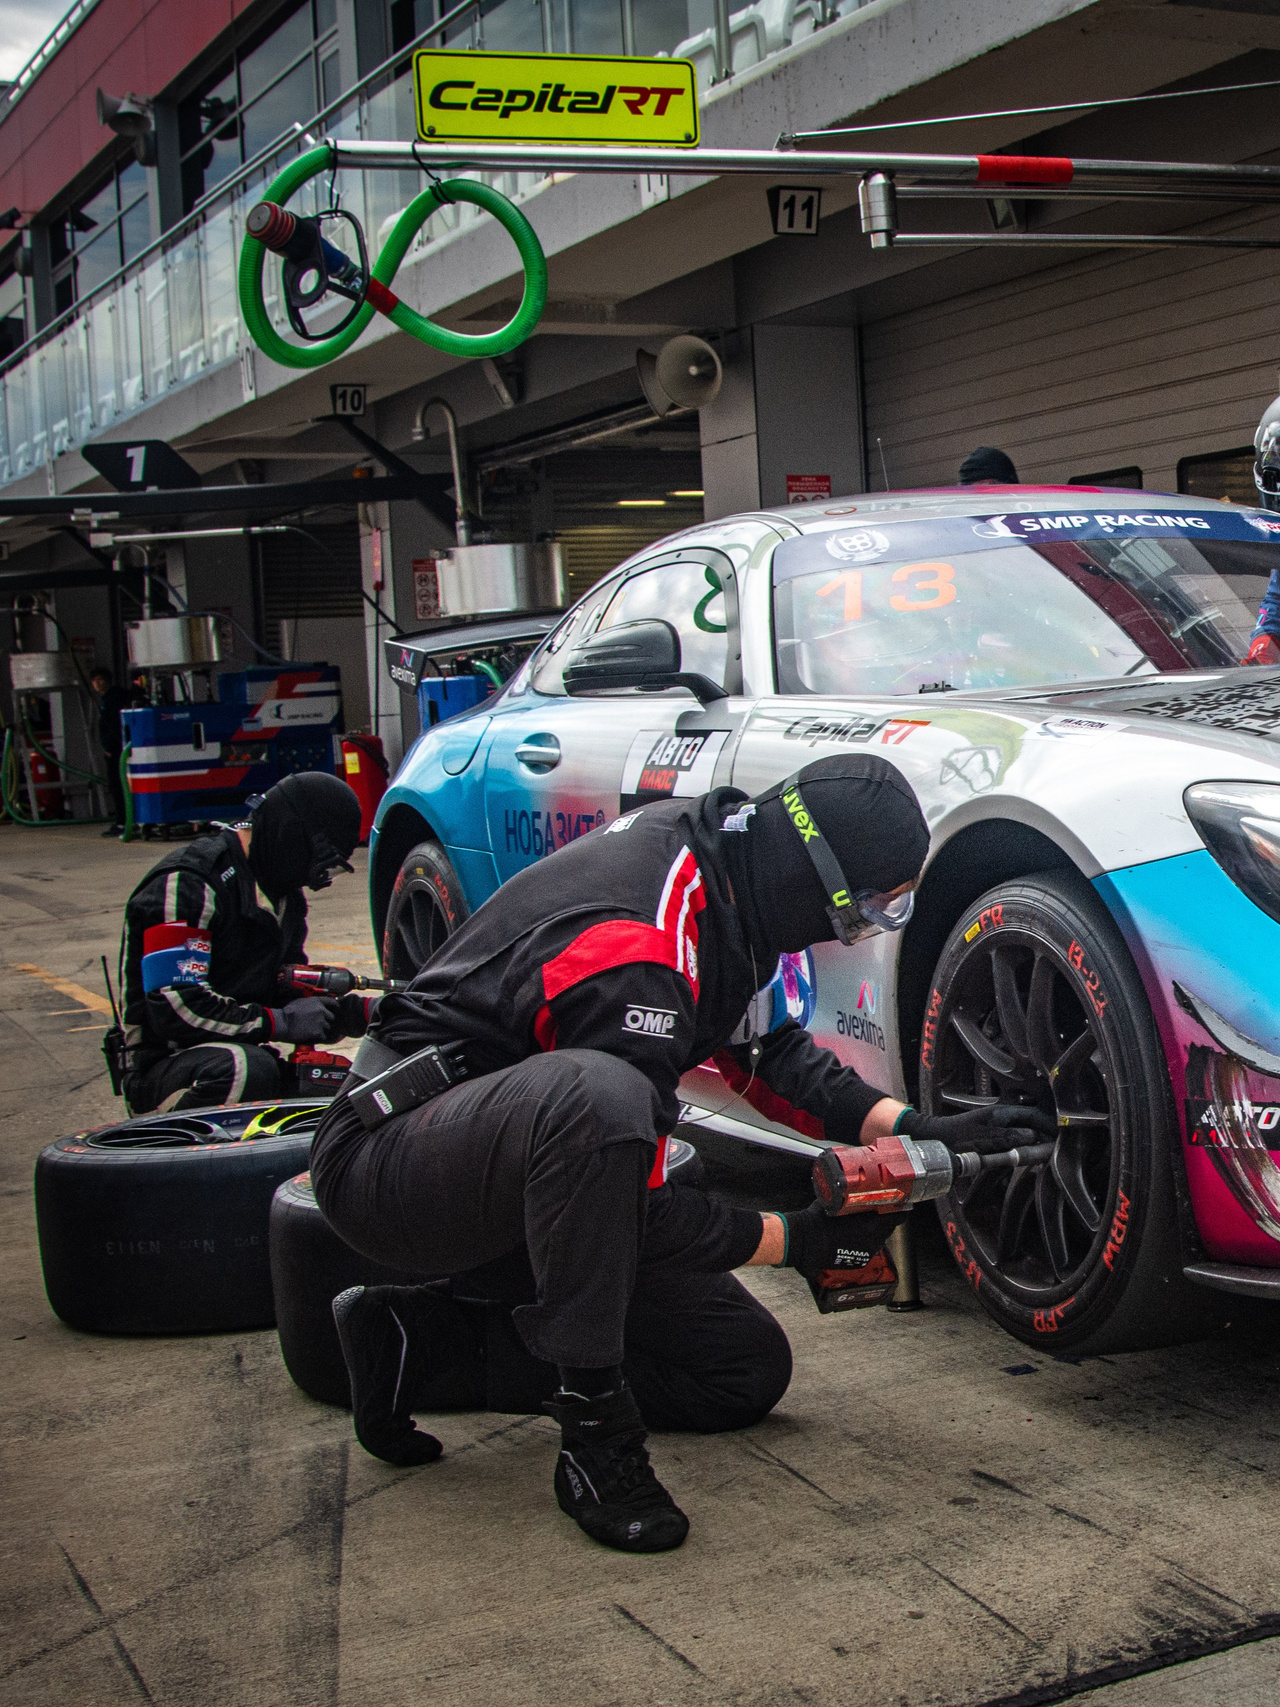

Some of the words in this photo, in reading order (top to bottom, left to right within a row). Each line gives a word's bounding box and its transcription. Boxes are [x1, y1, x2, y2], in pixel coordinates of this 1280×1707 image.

[428, 80, 685, 119] CapitalRT
[783, 194, 815, 229] 11
[338, 389, 362, 412] 10
[1021, 514, 1089, 532] SMP
[1095, 514, 1211, 530] RACING
[815, 562, 957, 622] 13
[783, 716, 931, 748] CapitalRT
[646, 737, 704, 766] АВТО
[638, 770, 675, 790] ПЛЮС
[783, 787, 819, 843] uvex
[979, 904, 1004, 933] FR
[624, 1009, 676, 1034] OMP
[836, 1010, 886, 1052] avexima
[1103, 1187, 1130, 1272] MRW
[837, 1249, 869, 1257] ПАЛМА
